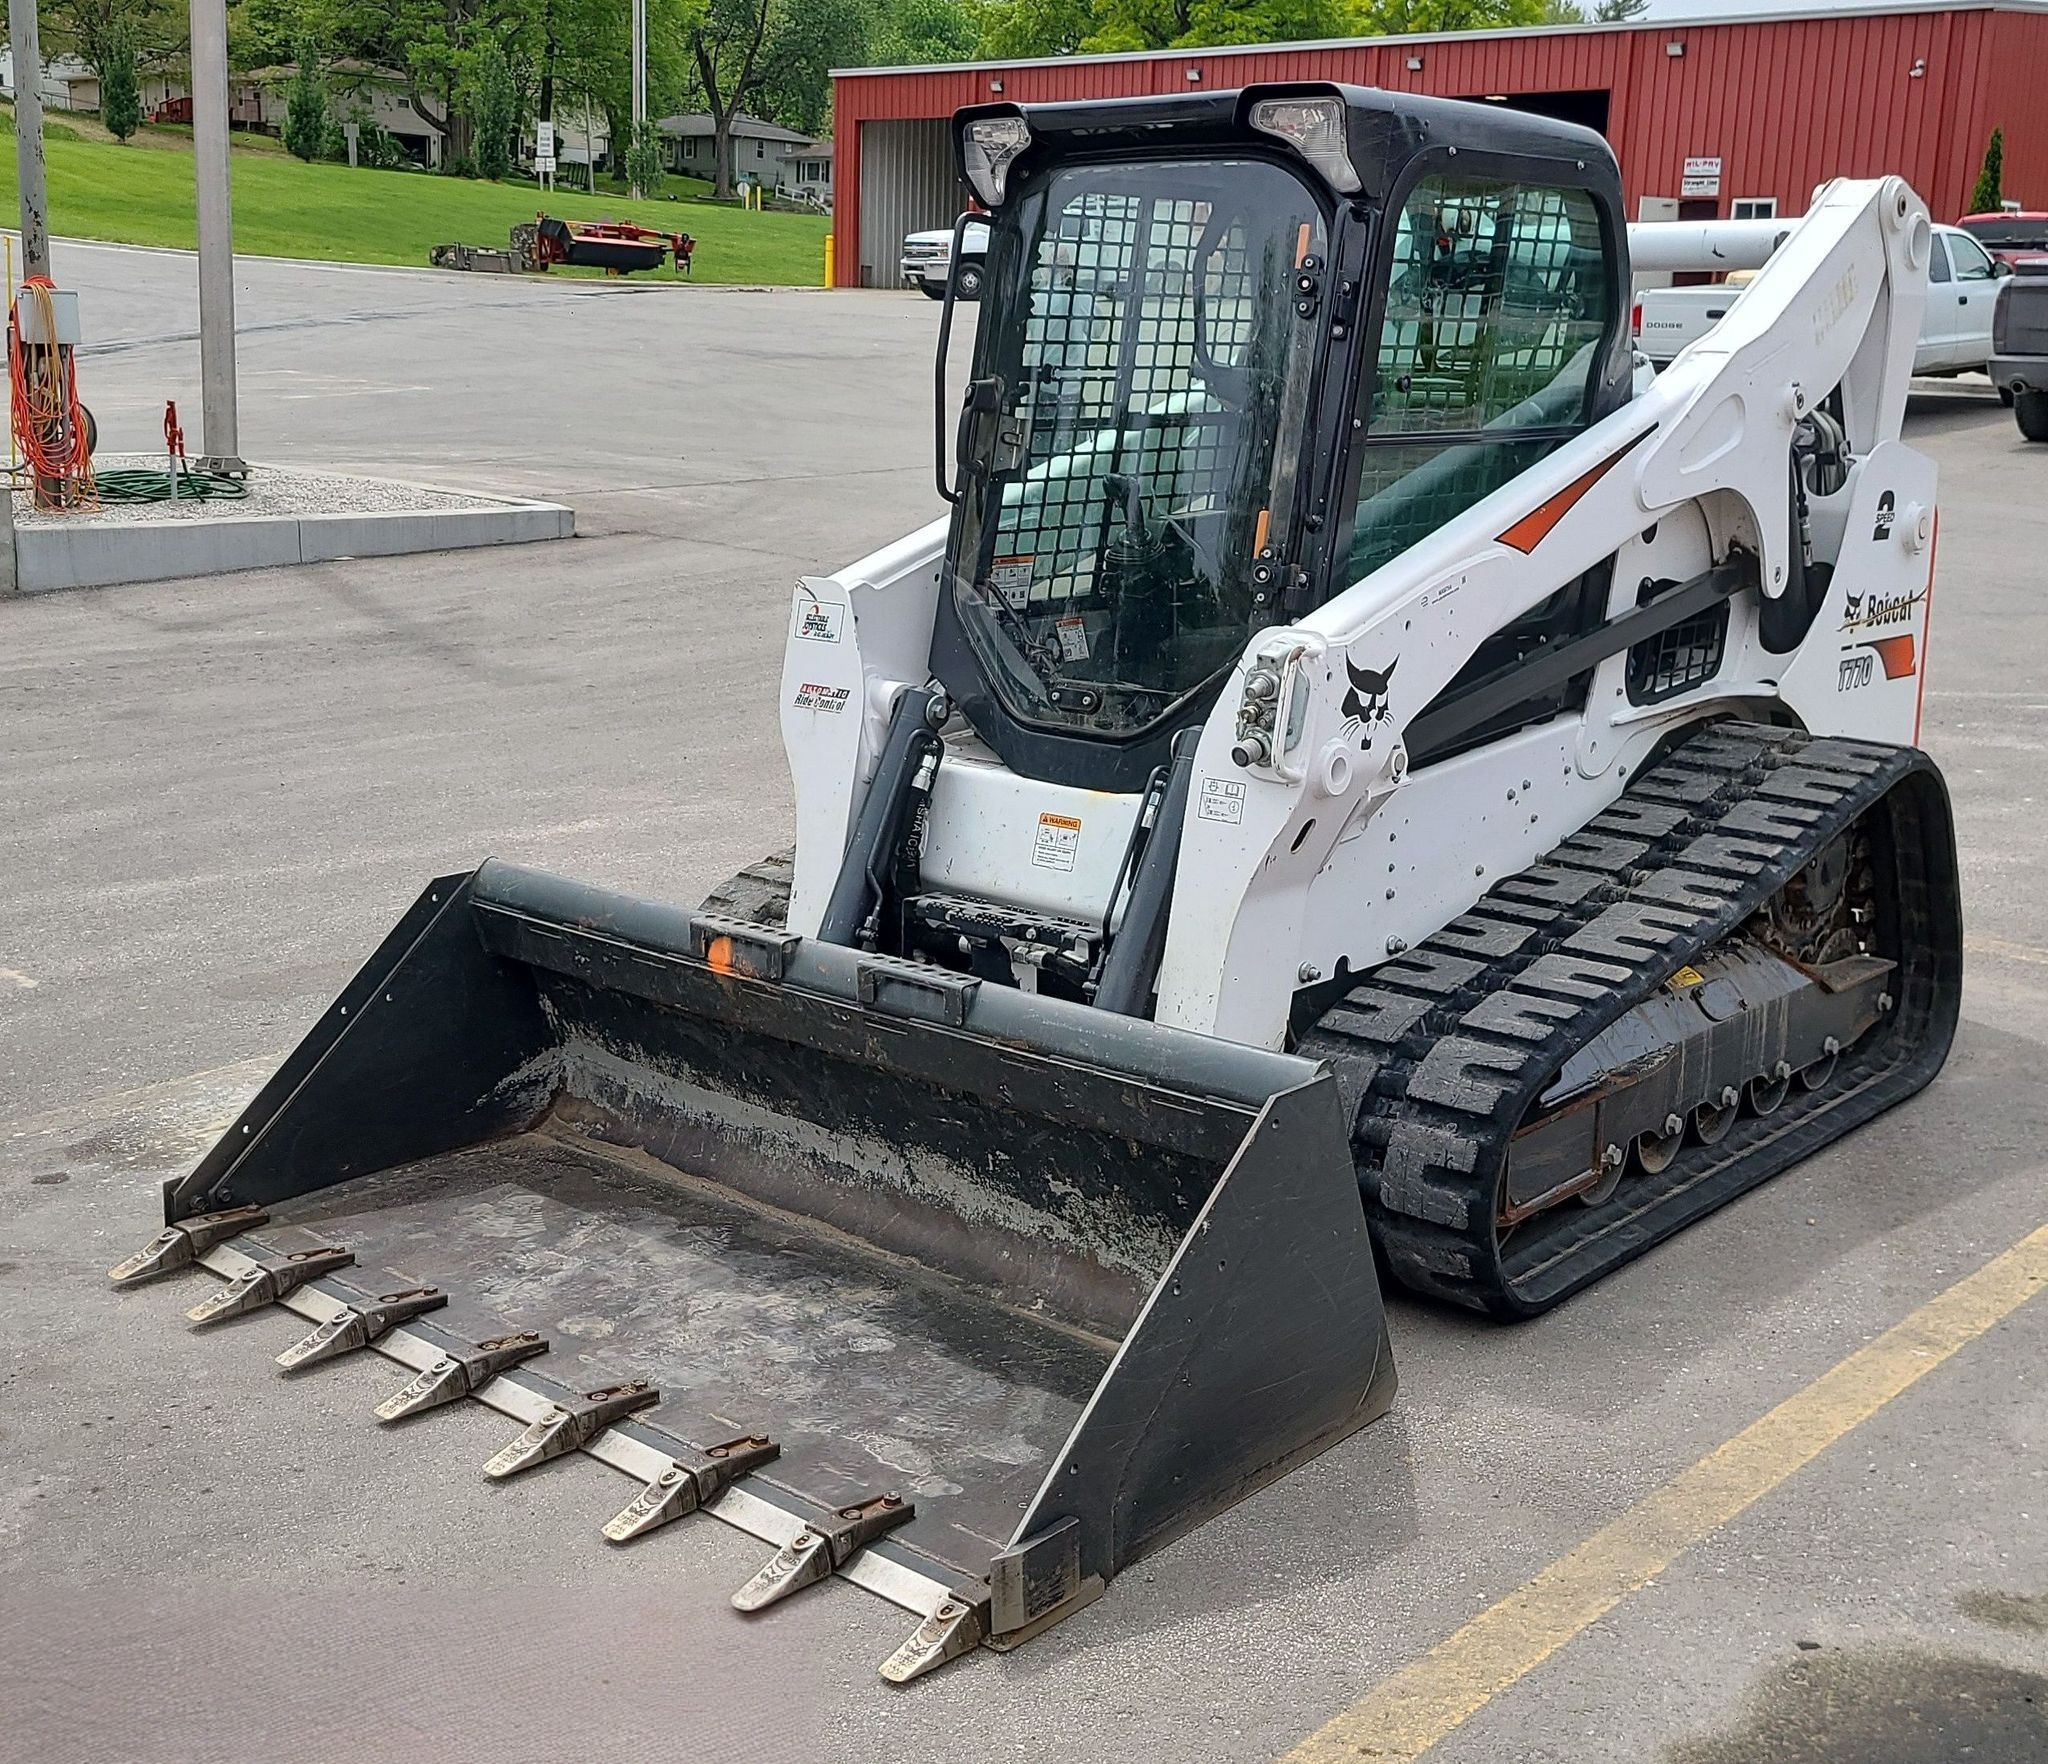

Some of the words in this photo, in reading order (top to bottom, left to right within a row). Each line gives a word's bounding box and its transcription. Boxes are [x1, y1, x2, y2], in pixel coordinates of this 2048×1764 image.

[1875, 512, 1895, 523] SPEED
[1866, 590, 1913, 627] Bobcat
[1838, 655, 1873, 692] T770
[795, 694, 812, 706] Ride
[813, 698, 846, 711] Control
[1049, 816, 1078, 828] WARNING
